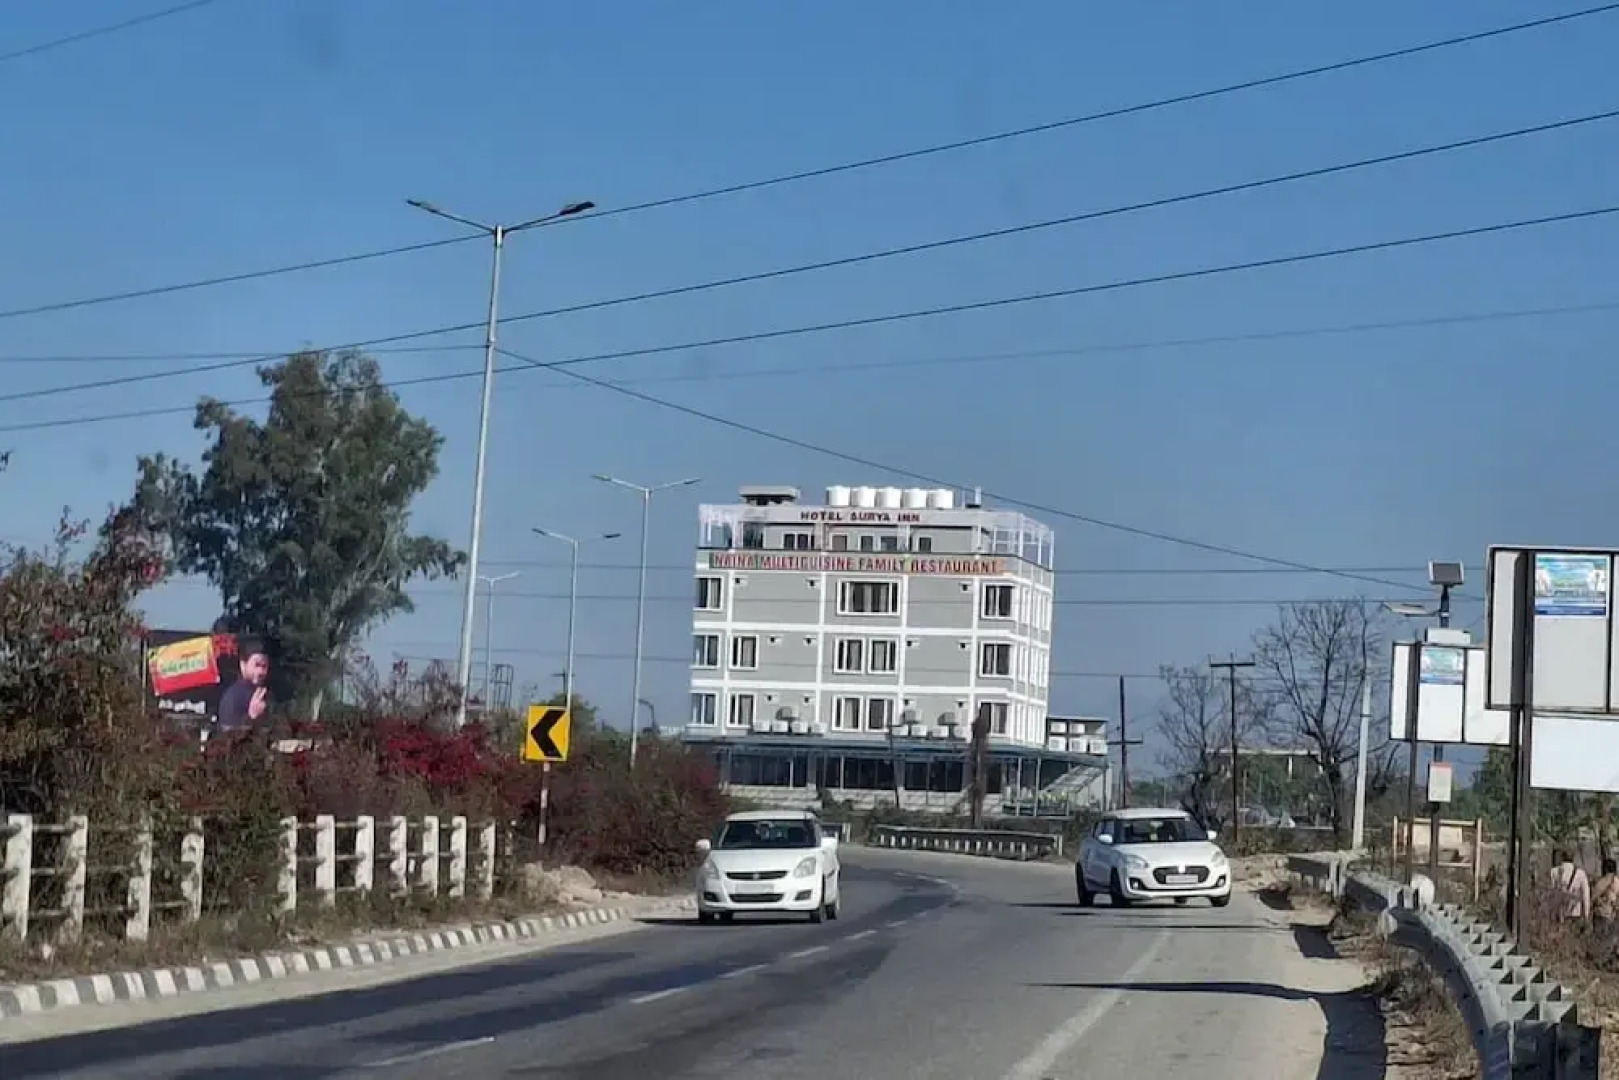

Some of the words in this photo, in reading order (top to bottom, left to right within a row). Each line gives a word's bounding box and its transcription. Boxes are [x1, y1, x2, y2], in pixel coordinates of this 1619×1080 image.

[800, 511, 843, 521] HOTEL
[849, 511, 890, 521] SURYA
[897, 512, 919, 522] INN
[858, 557, 906, 571] FAMILY
[911, 559, 997, 573] RESTAURANT
